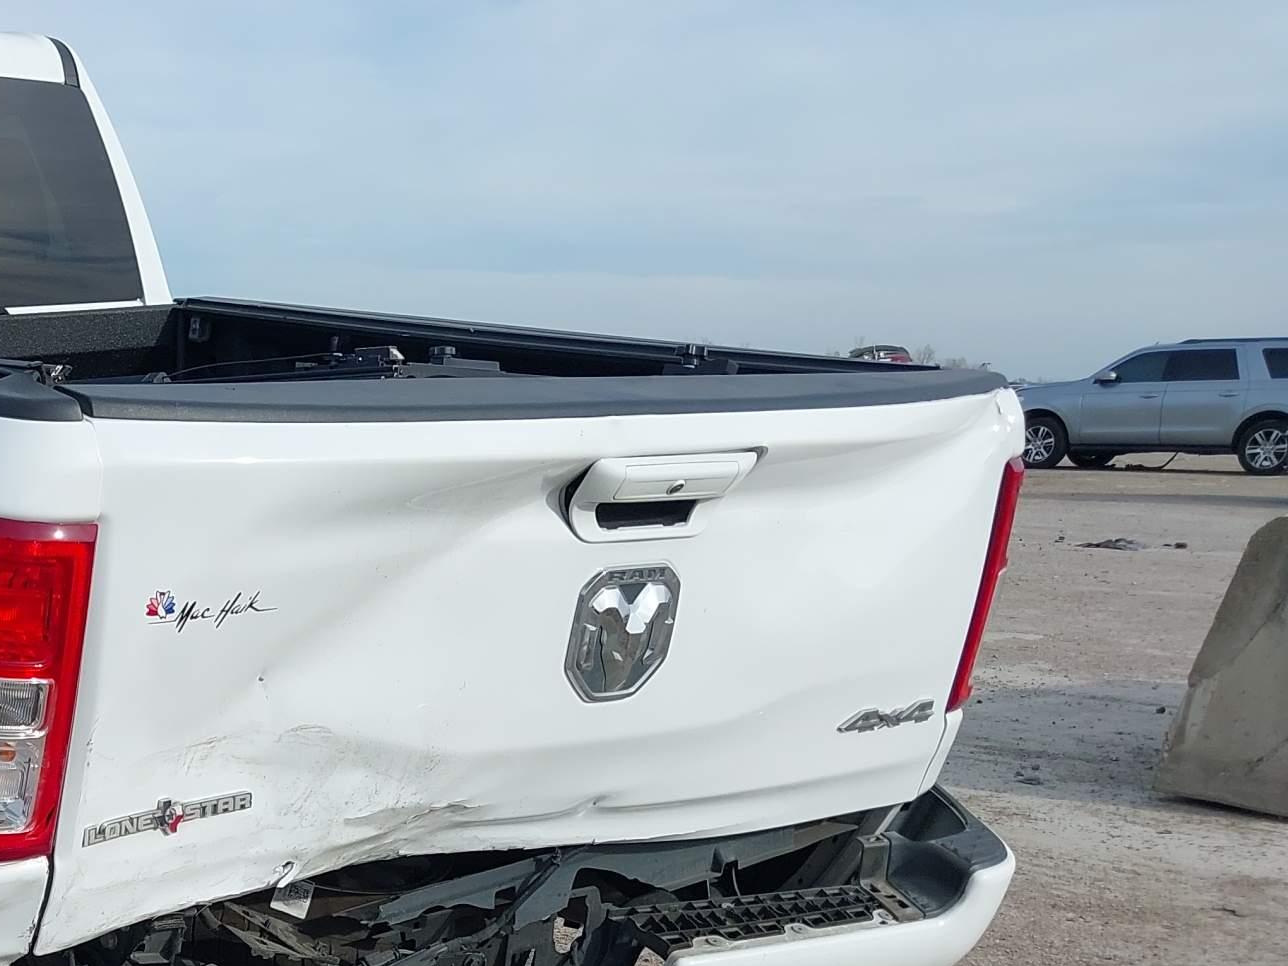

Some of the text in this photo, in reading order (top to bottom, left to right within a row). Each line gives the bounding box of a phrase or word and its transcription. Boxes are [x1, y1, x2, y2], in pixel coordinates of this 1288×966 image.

[607, 567, 666, 584] RAM
[174, 590, 278, 633] Mac Haik
[82, 791, 253, 848] LONE STAR
